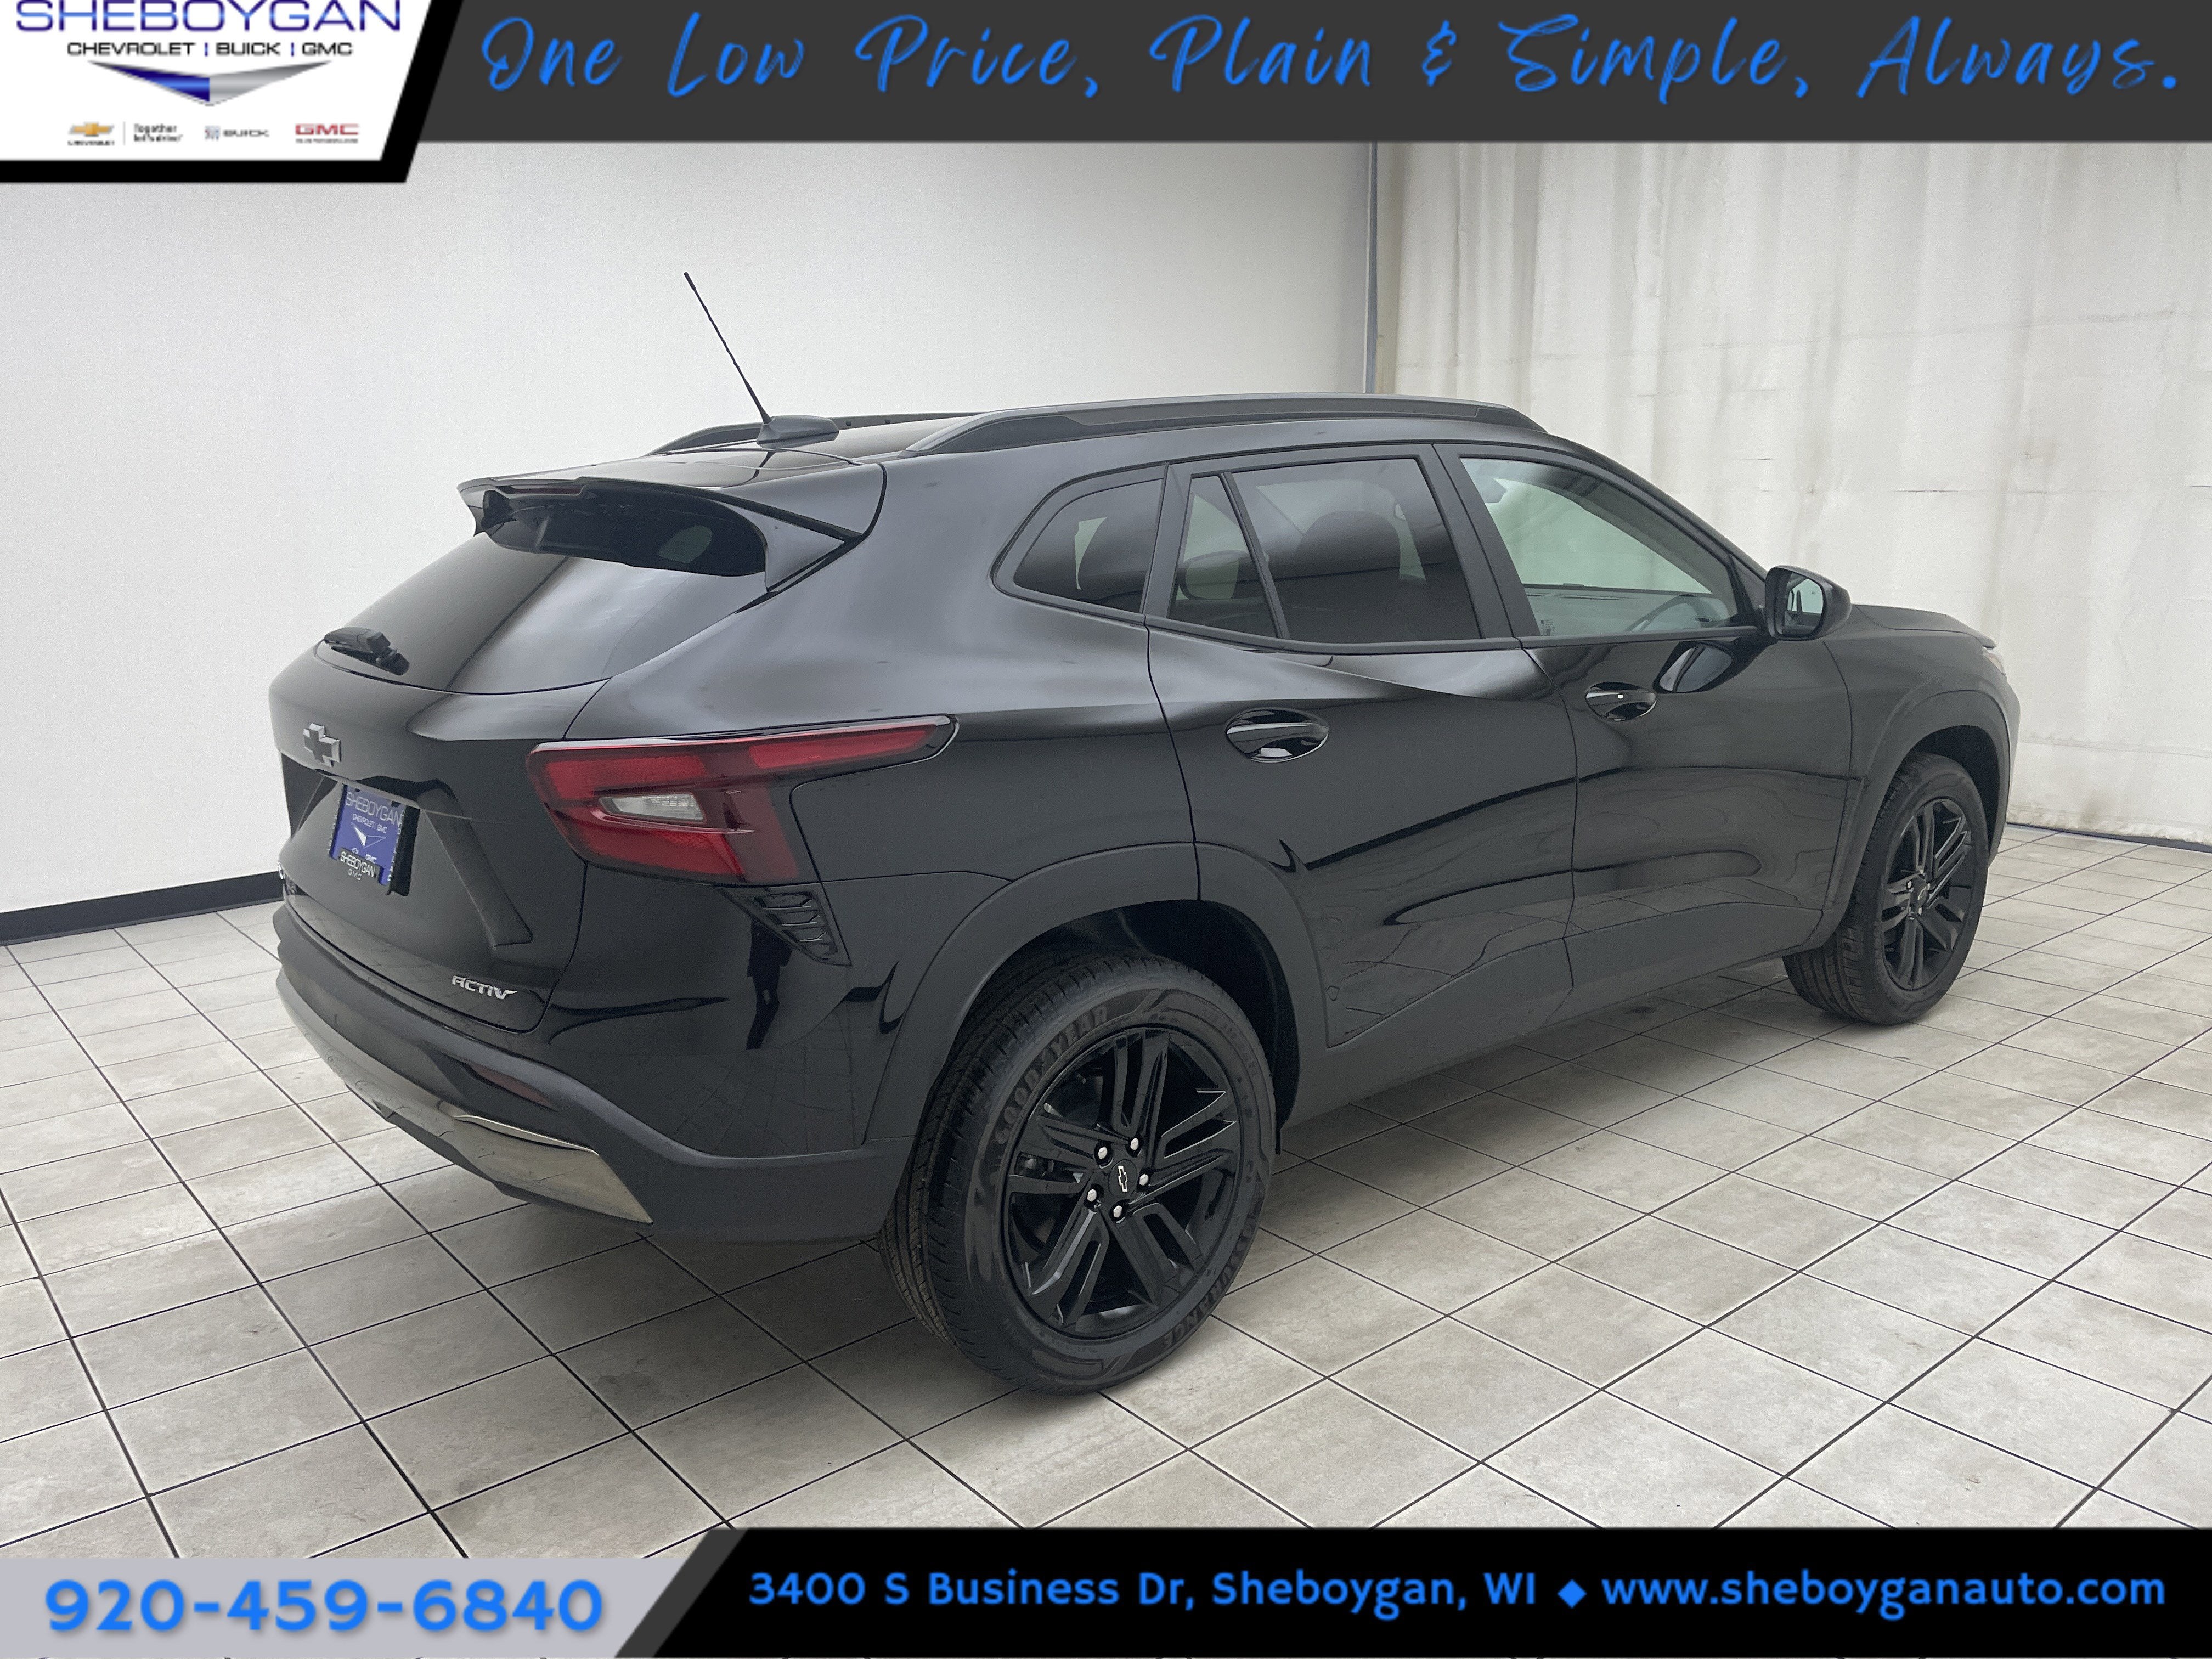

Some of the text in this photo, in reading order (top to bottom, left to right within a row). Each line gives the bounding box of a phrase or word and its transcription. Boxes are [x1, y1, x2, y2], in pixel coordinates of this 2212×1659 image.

[346, 792, 403, 827] SHEBOYGAN
[377, 823, 387, 834] GMC
[340, 851, 376, 878] SHEBOYGAN
[365, 854, 377, 864] GMC
[348, 868, 362, 881] GMC
[452, 975, 517, 1000] ACTIV
